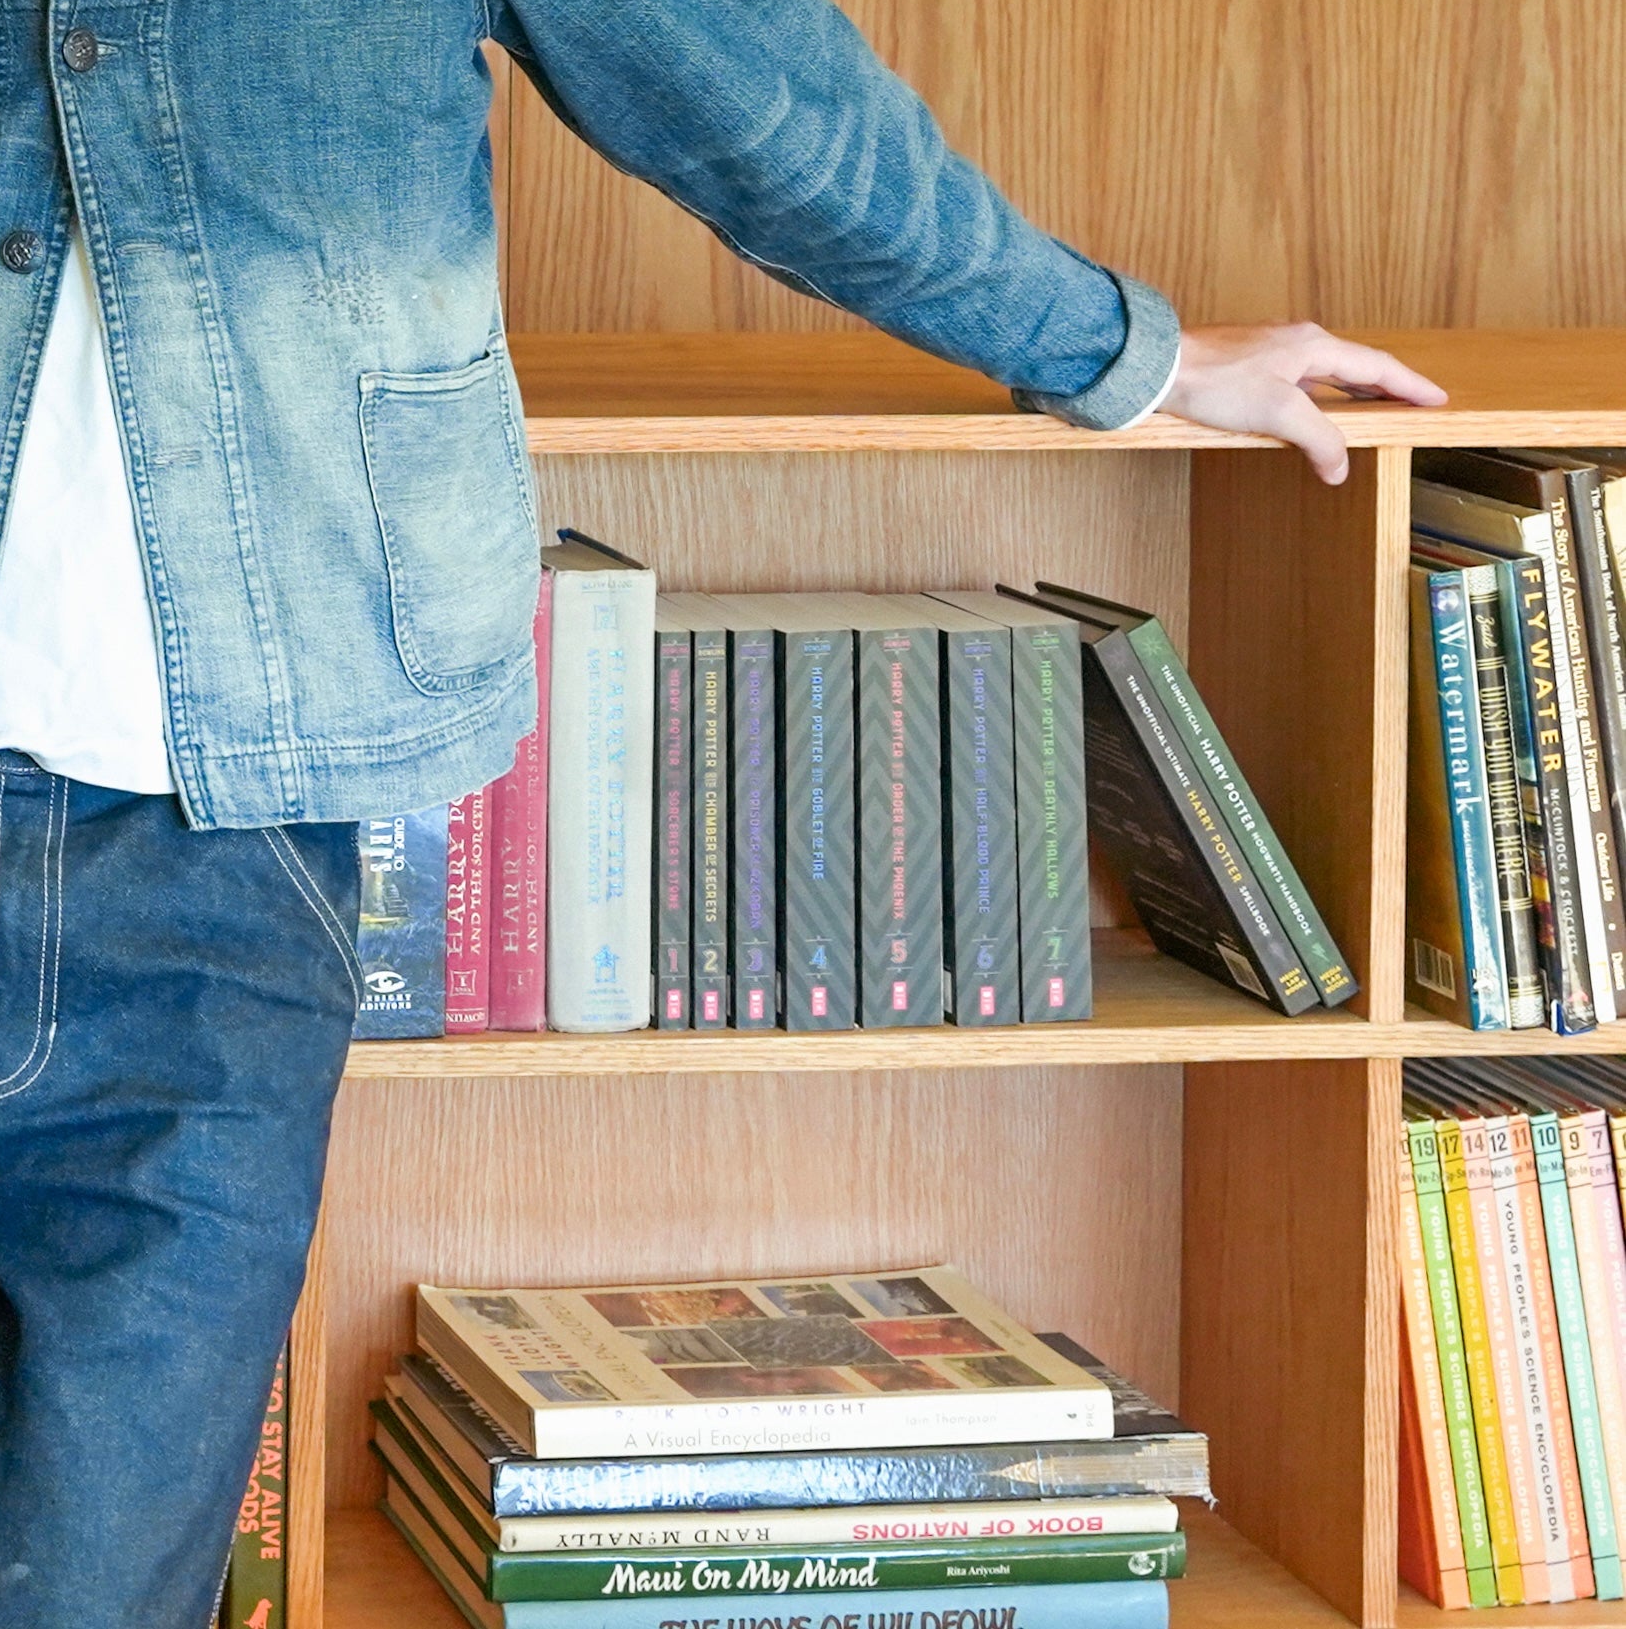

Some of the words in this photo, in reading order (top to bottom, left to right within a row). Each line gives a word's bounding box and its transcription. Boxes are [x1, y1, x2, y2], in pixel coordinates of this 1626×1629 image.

[1551, 497, 1565, 527] The
[1552, 528, 1571, 566] Story
[1560, 569, 1574, 583] of
[1562, 586, 1581, 656] American
[1040, 660, 1053, 703] HARRY
[1522, 568, 1562, 772] FLYWATER
[1572, 658, 1591, 718] Hunting
[705, 671, 717, 714] HARRY
[1480, 686, 1510, 732] WISH
[1042, 708, 1054, 755] POTTER
[1437, 620, 1482, 814] Watermark
[1579, 720, 1596, 745] and
[705, 720, 717, 767] POTTER
[1483, 738, 1514, 774] YOU
[1161, 664, 1175, 683] THE
[1170, 683, 1203, 736] UNOFFICIAL
[1199, 738, 1230, 781] HARRY
[1223, 782, 1256, 832] POTTER
[1251, 832, 1285, 883] HOGWARTS
[1279, 883, 1313, 936] HANDBOOK
[1583, 749, 1603, 812] Firearms
[705, 791, 717, 851] CHAMBER
[1044, 780, 1057, 835] DEATHLY
[1126, 675, 1137, 694] THE
[1136, 694, 1167, 746] UNOFFICIAL
[1164, 745, 1191, 788] ULTIMATE
[1187, 790, 1216, 832] HARRY
[1210, 834, 1243, 883] POTTER
[1239, 886, 1271, 936] SPELLBOOK
[1489, 779, 1520, 827] WERE
[1549, 788, 1569, 871] McCLINTOCK
[706, 854, 717, 866] OF
[1046, 840, 1059, 899] HALLOWS
[1494, 835, 1525, 880] HERE
[705, 868, 717, 922] SECRETS
[1560, 876, 1571, 884] &
[1561, 889, 1579, 956] CROCKETT
[702, 949, 718, 972] 2
[1047, 937, 1062, 960] 7
[1414, 1136, 1435, 1157] 19
[1489, 1132, 1508, 1152] 12
[1591, 1131, 1603, 1149] 7
[1504, 1200, 1518, 1255] YOUNG
[1513, 1263, 1531, 1339] PEOPLE'S
[1523, 1347, 1542, 1415] SCIENCE
[1534, 1423, 1559, 1543] ENCYCLOPEDIA
[777, 1403, 866, 1416] WRIGHT
[262, 1422, 283, 1480] STAY
[624, 1433, 638, 1448] A
[647, 1431, 702, 1448] Visual
[711, 1427, 831, 1451] Encyclopedia
[260, 1489, 282, 1559] ALIVE
[853, 1521, 969, 1541] NATIONS
[979, 1518, 1015, 1535] OF
[1027, 1515, 1104, 1534] BOOK
[601, 1561, 688, 1593] Maui
[691, 1560, 732, 1590] On
[736, 1559, 791, 1593] My
[792, 1555, 880, 1589] Mind
[946, 1565, 966, 1577] Rita
[967, 1564, 1010, 1579] Ariyoshi
